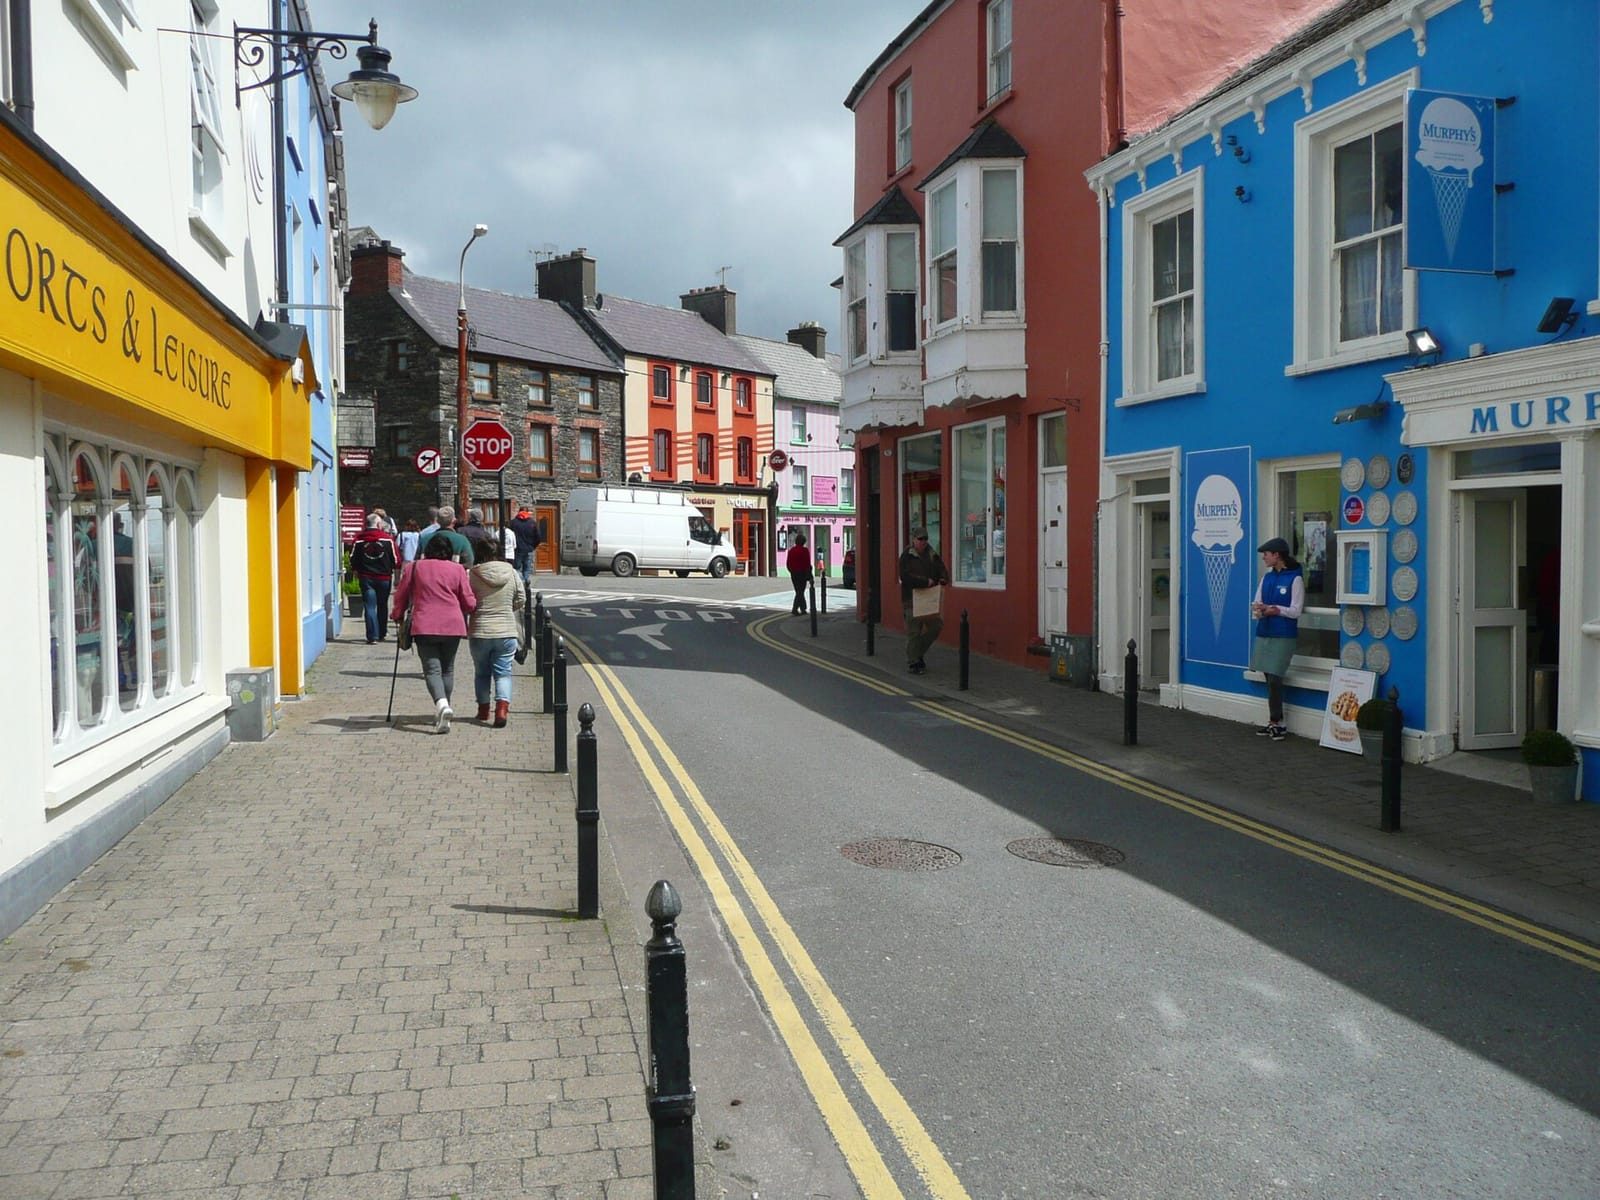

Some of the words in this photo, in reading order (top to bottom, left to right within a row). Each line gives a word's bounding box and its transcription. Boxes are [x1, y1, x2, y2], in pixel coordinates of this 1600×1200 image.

[1423, 122, 1477, 142] MURPHY'S
[121, 290, 142, 363] &
[151, 306, 232, 410] LEISURE
[464, 437, 511, 455] STOP
[1196, 500, 1238, 517] MURPHY'S
[559, 607, 736, 623] STOP
